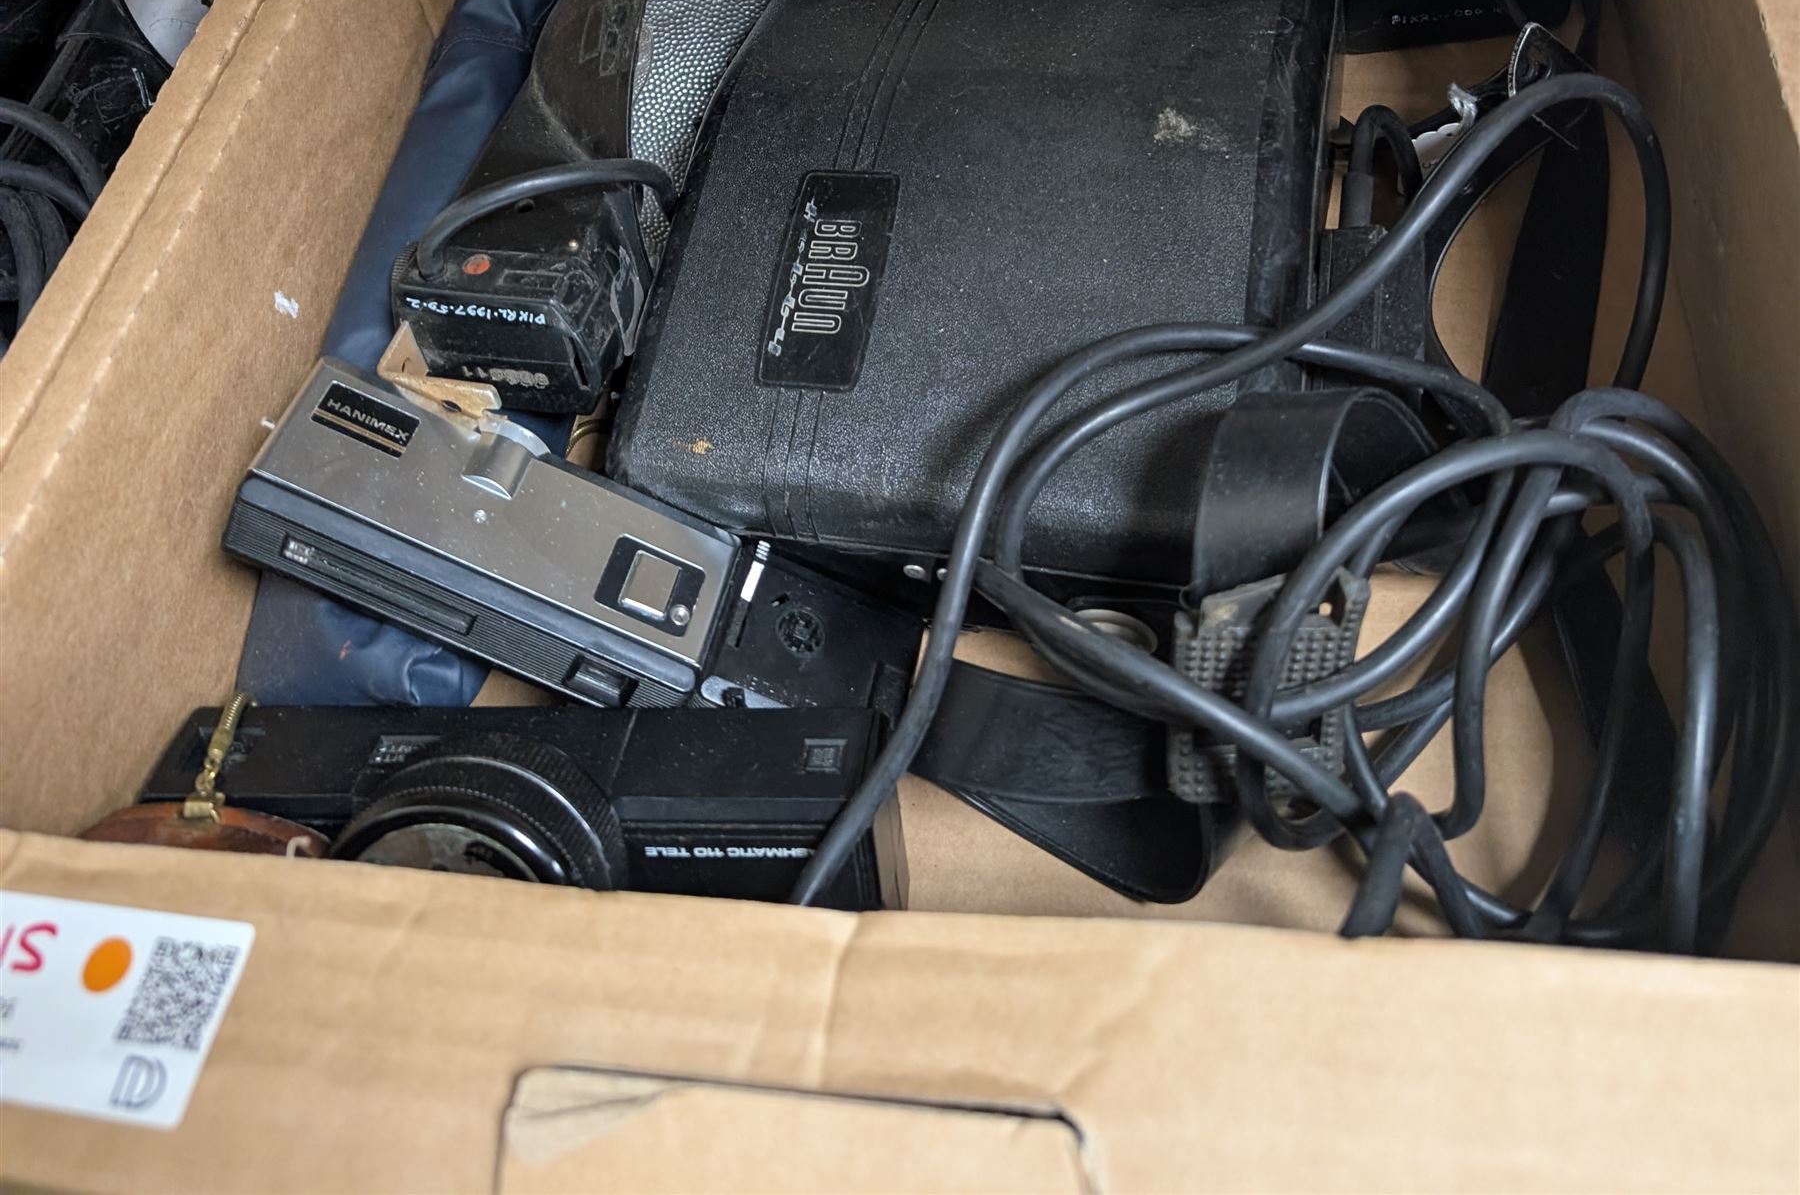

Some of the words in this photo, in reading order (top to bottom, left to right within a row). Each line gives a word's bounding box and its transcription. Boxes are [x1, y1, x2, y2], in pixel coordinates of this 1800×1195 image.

[791, 218, 870, 334] BRAUN
[326, 398, 410, 442] HANIMEX
[644, 846, 691, 859] TELE
[693, 846, 725, 858] 110
[726, 846, 815, 858] SHMATIC
